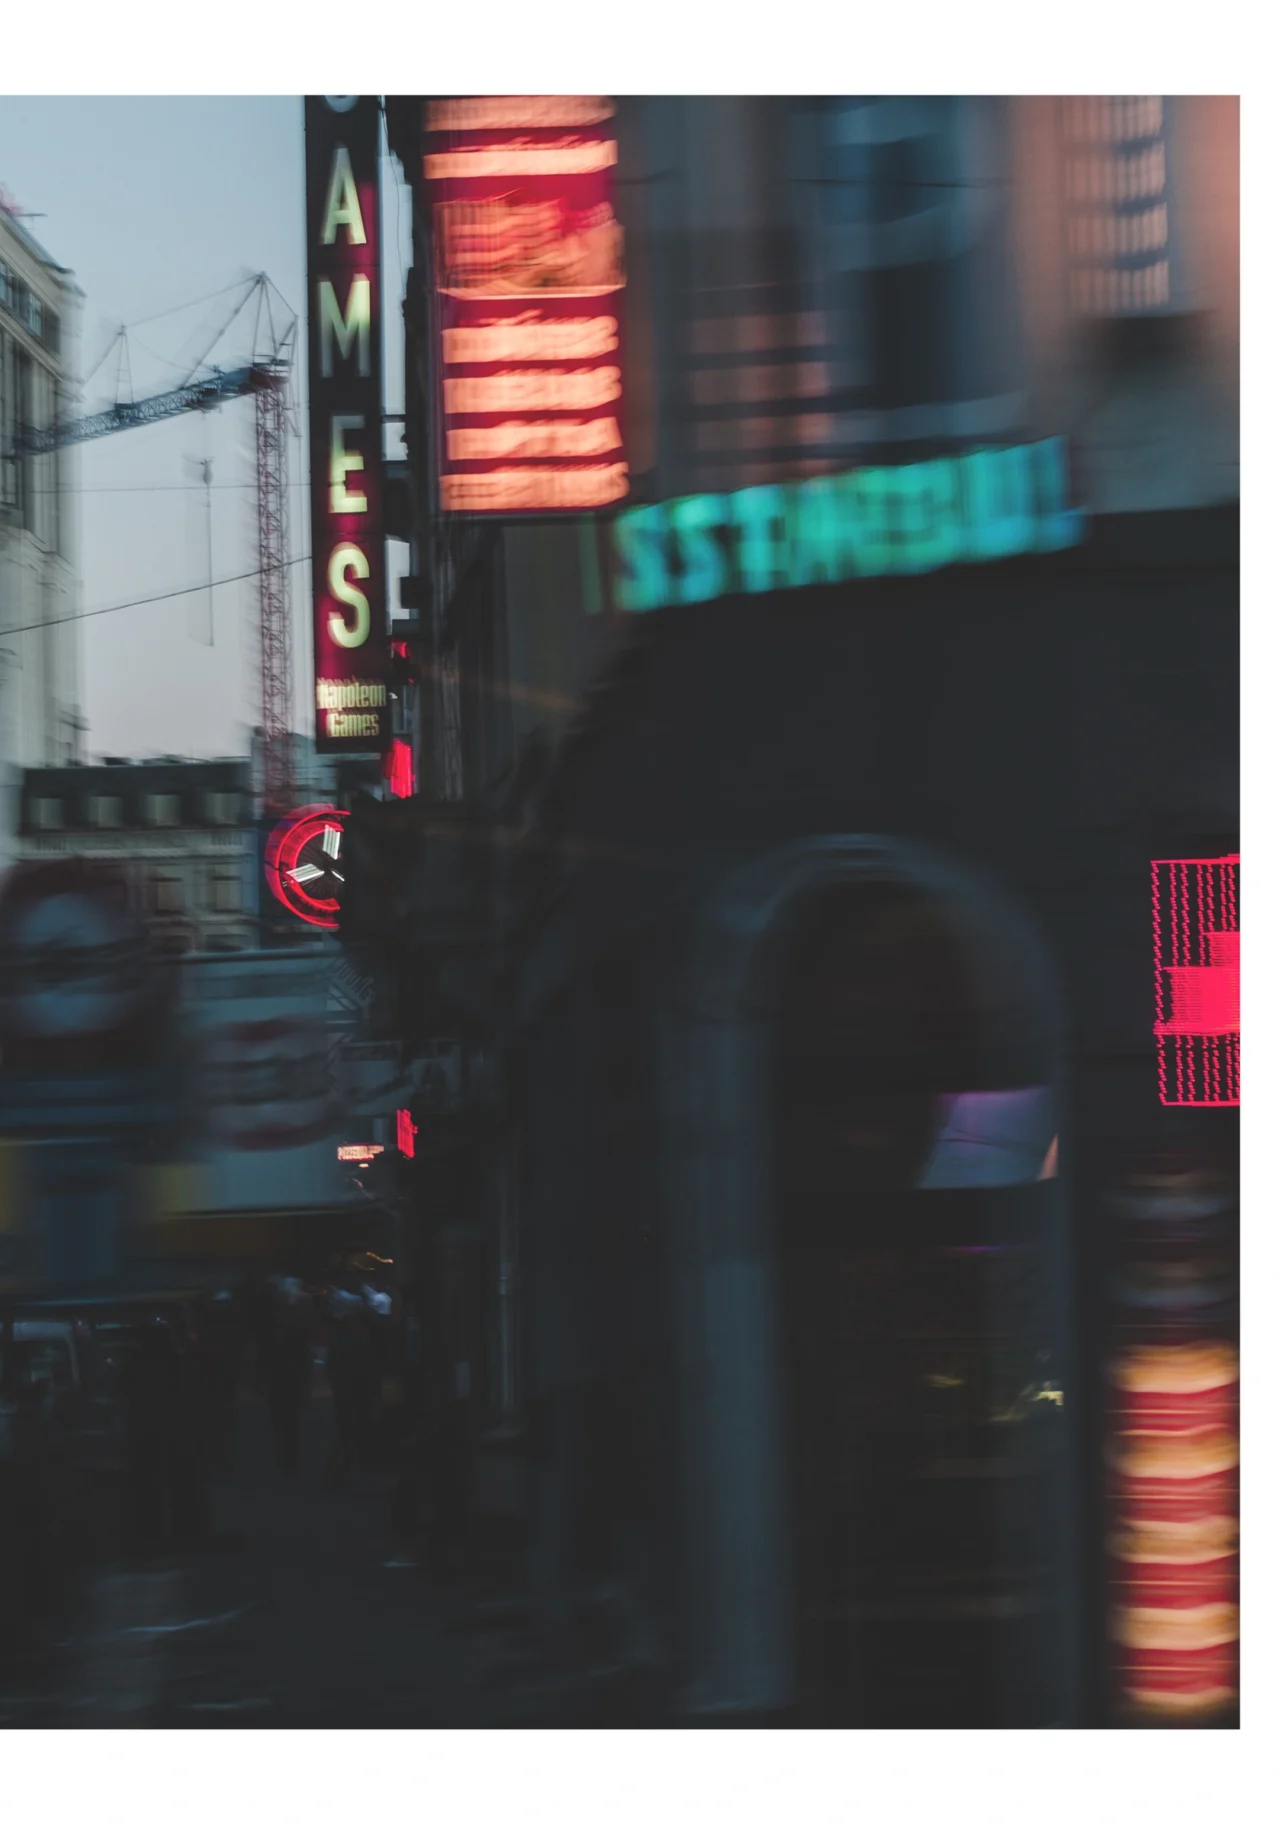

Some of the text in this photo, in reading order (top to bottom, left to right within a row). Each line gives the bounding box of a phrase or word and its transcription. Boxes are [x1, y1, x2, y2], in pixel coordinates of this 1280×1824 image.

[318, 95, 372, 650] AMES
[316, 680, 387, 711] Napoleon
[327, 712, 379, 737] Games
